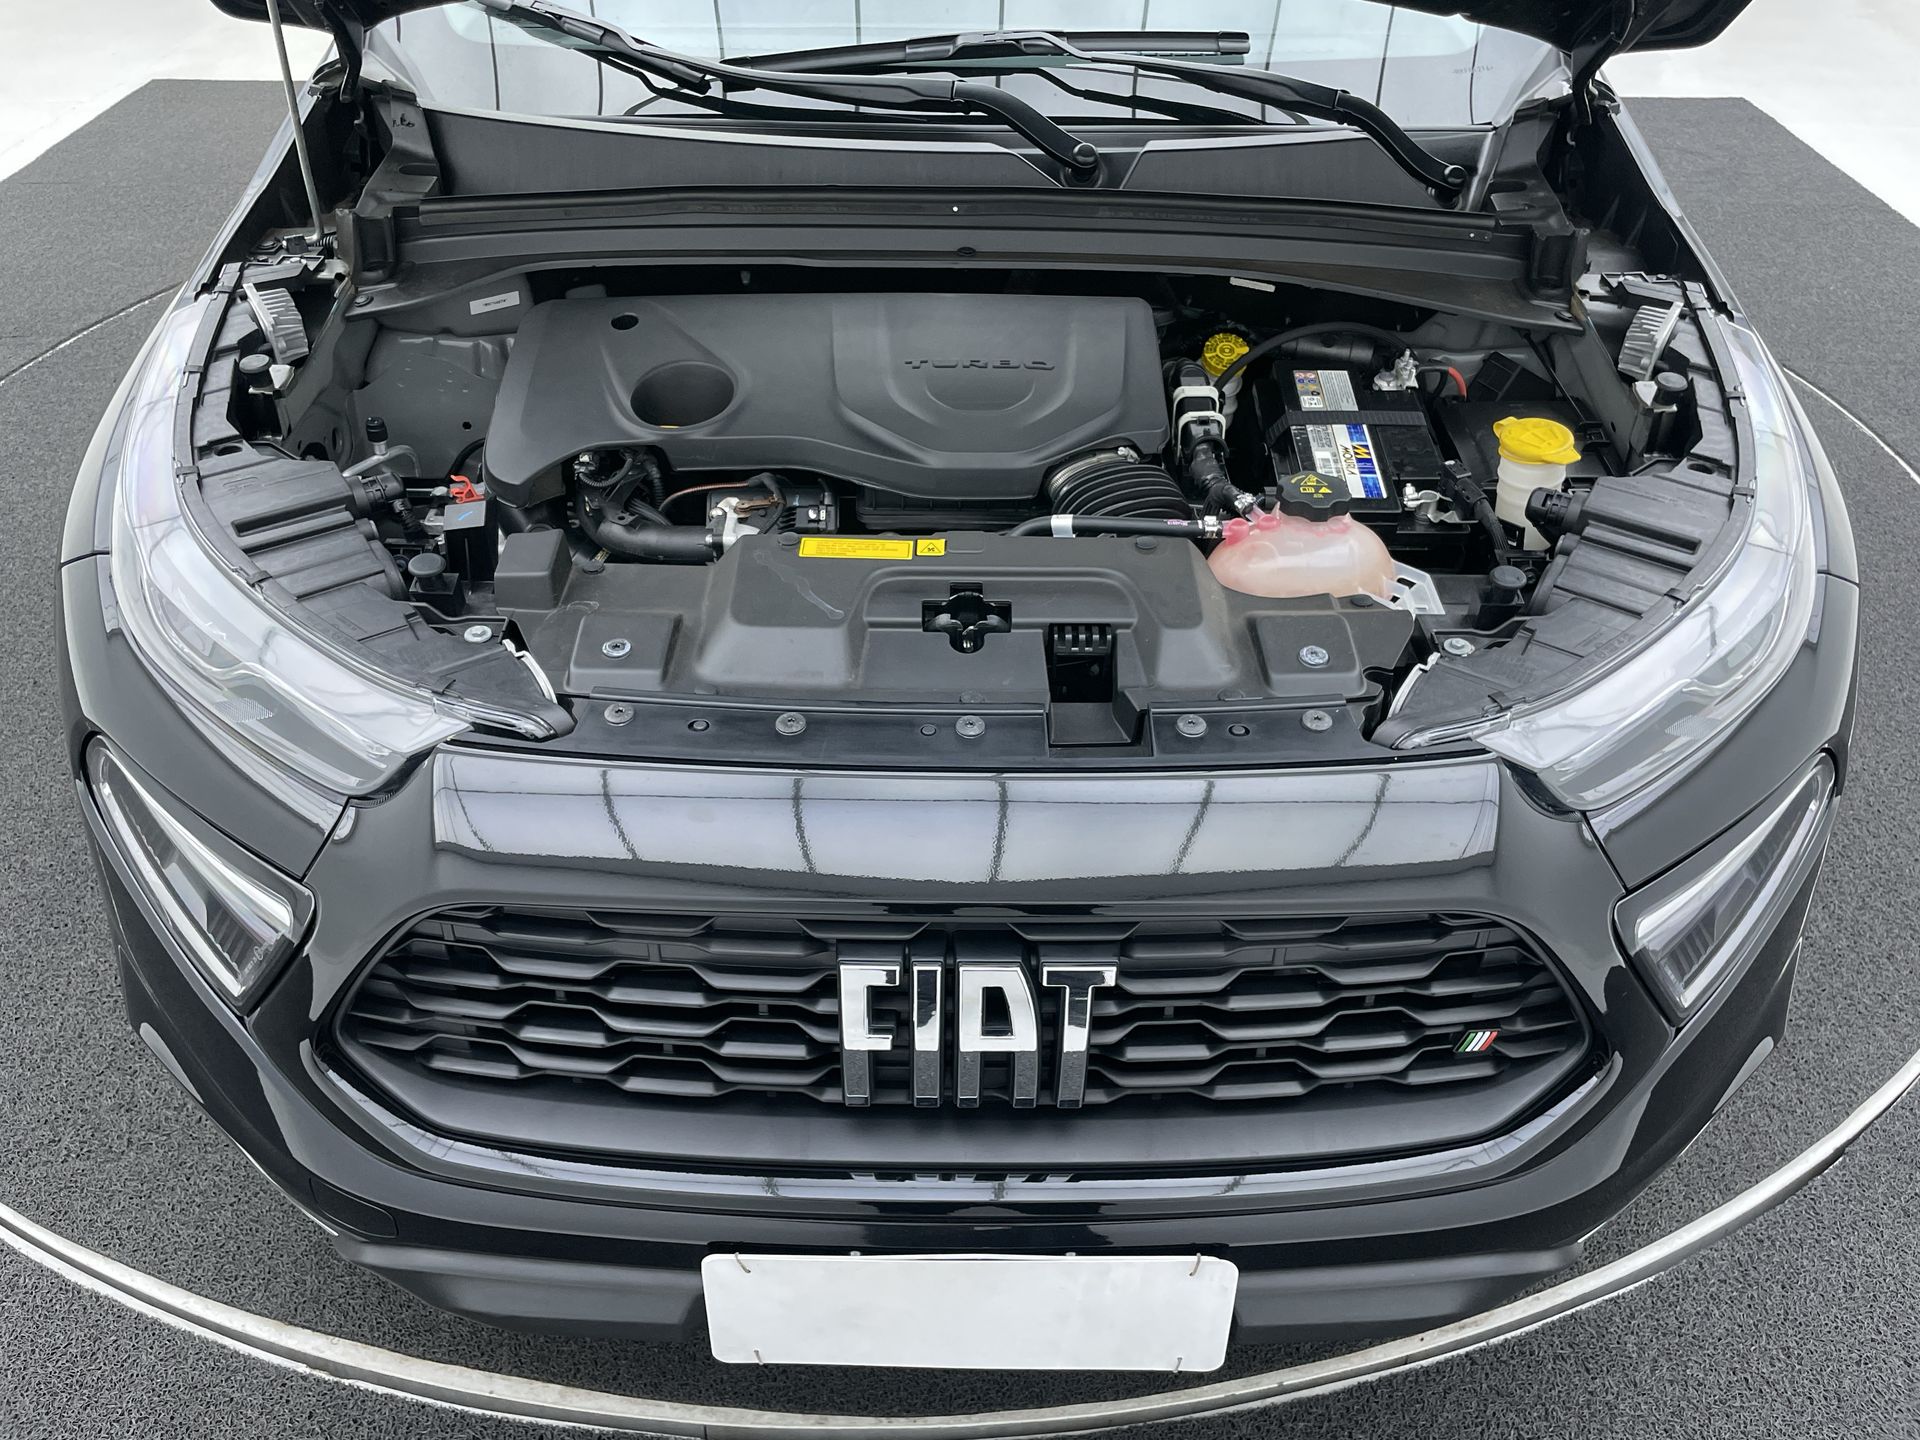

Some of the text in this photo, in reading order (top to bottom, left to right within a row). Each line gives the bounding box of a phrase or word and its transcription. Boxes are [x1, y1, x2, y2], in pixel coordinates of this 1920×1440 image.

[904, 358, 1056, 371] TURBO
[1339, 444, 1357, 475] MOURA
[837, 961, 1119, 1108] FIAT
